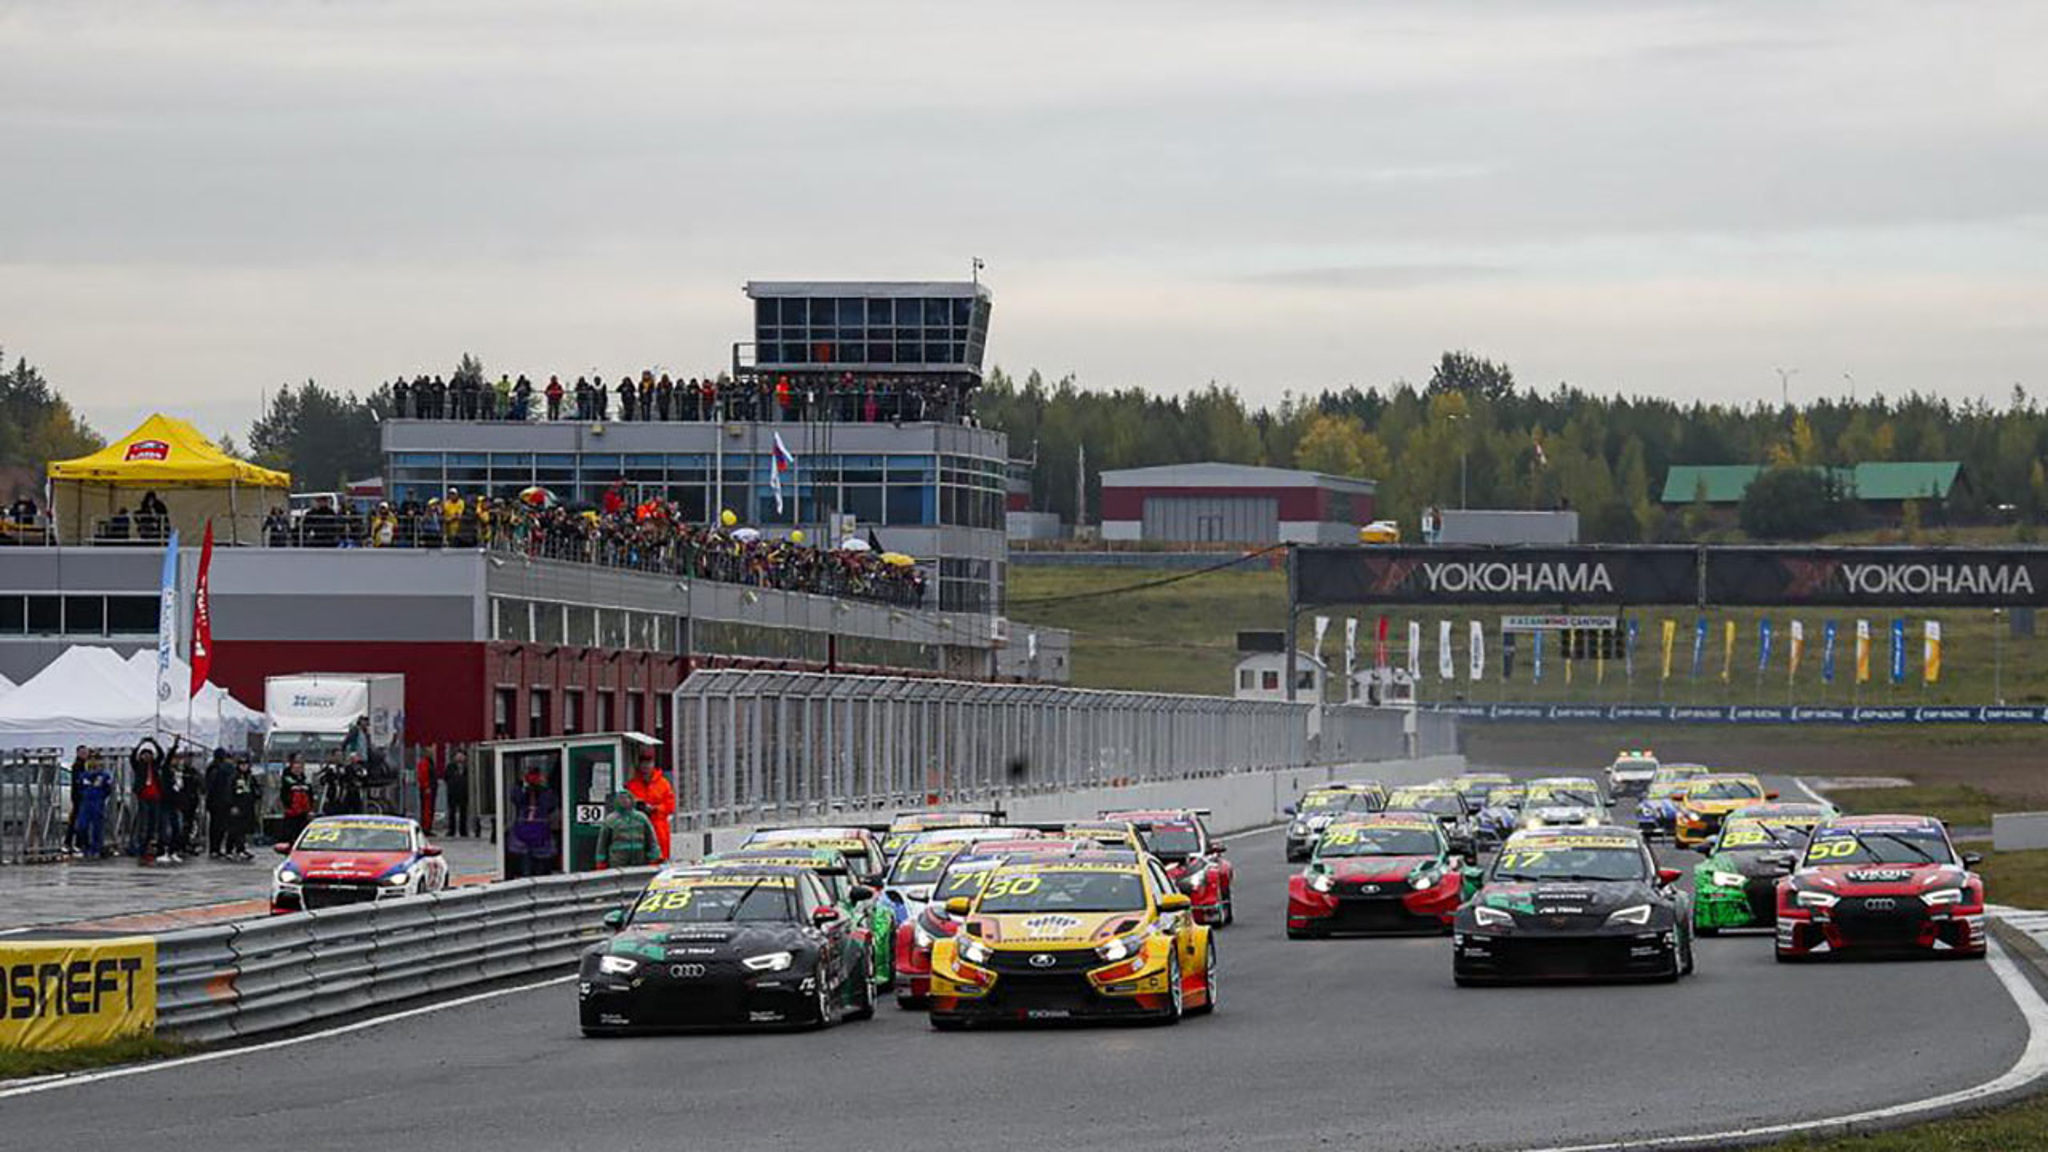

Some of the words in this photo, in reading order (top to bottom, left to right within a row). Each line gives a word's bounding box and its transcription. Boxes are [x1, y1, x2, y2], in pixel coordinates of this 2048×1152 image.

[1423, 562, 1613, 592] YOKOHAMA
[1842, 564, 2034, 593] YOKOHAMA
[580, 806, 602, 821] 30
[1500, 851, 1546, 869] 17
[1807, 840, 1858, 860] 50
[899, 854, 942, 874] 19
[950, 870, 989, 891] 71
[983, 876, 1042, 900] 30
[636, 890, 693, 914] 48
